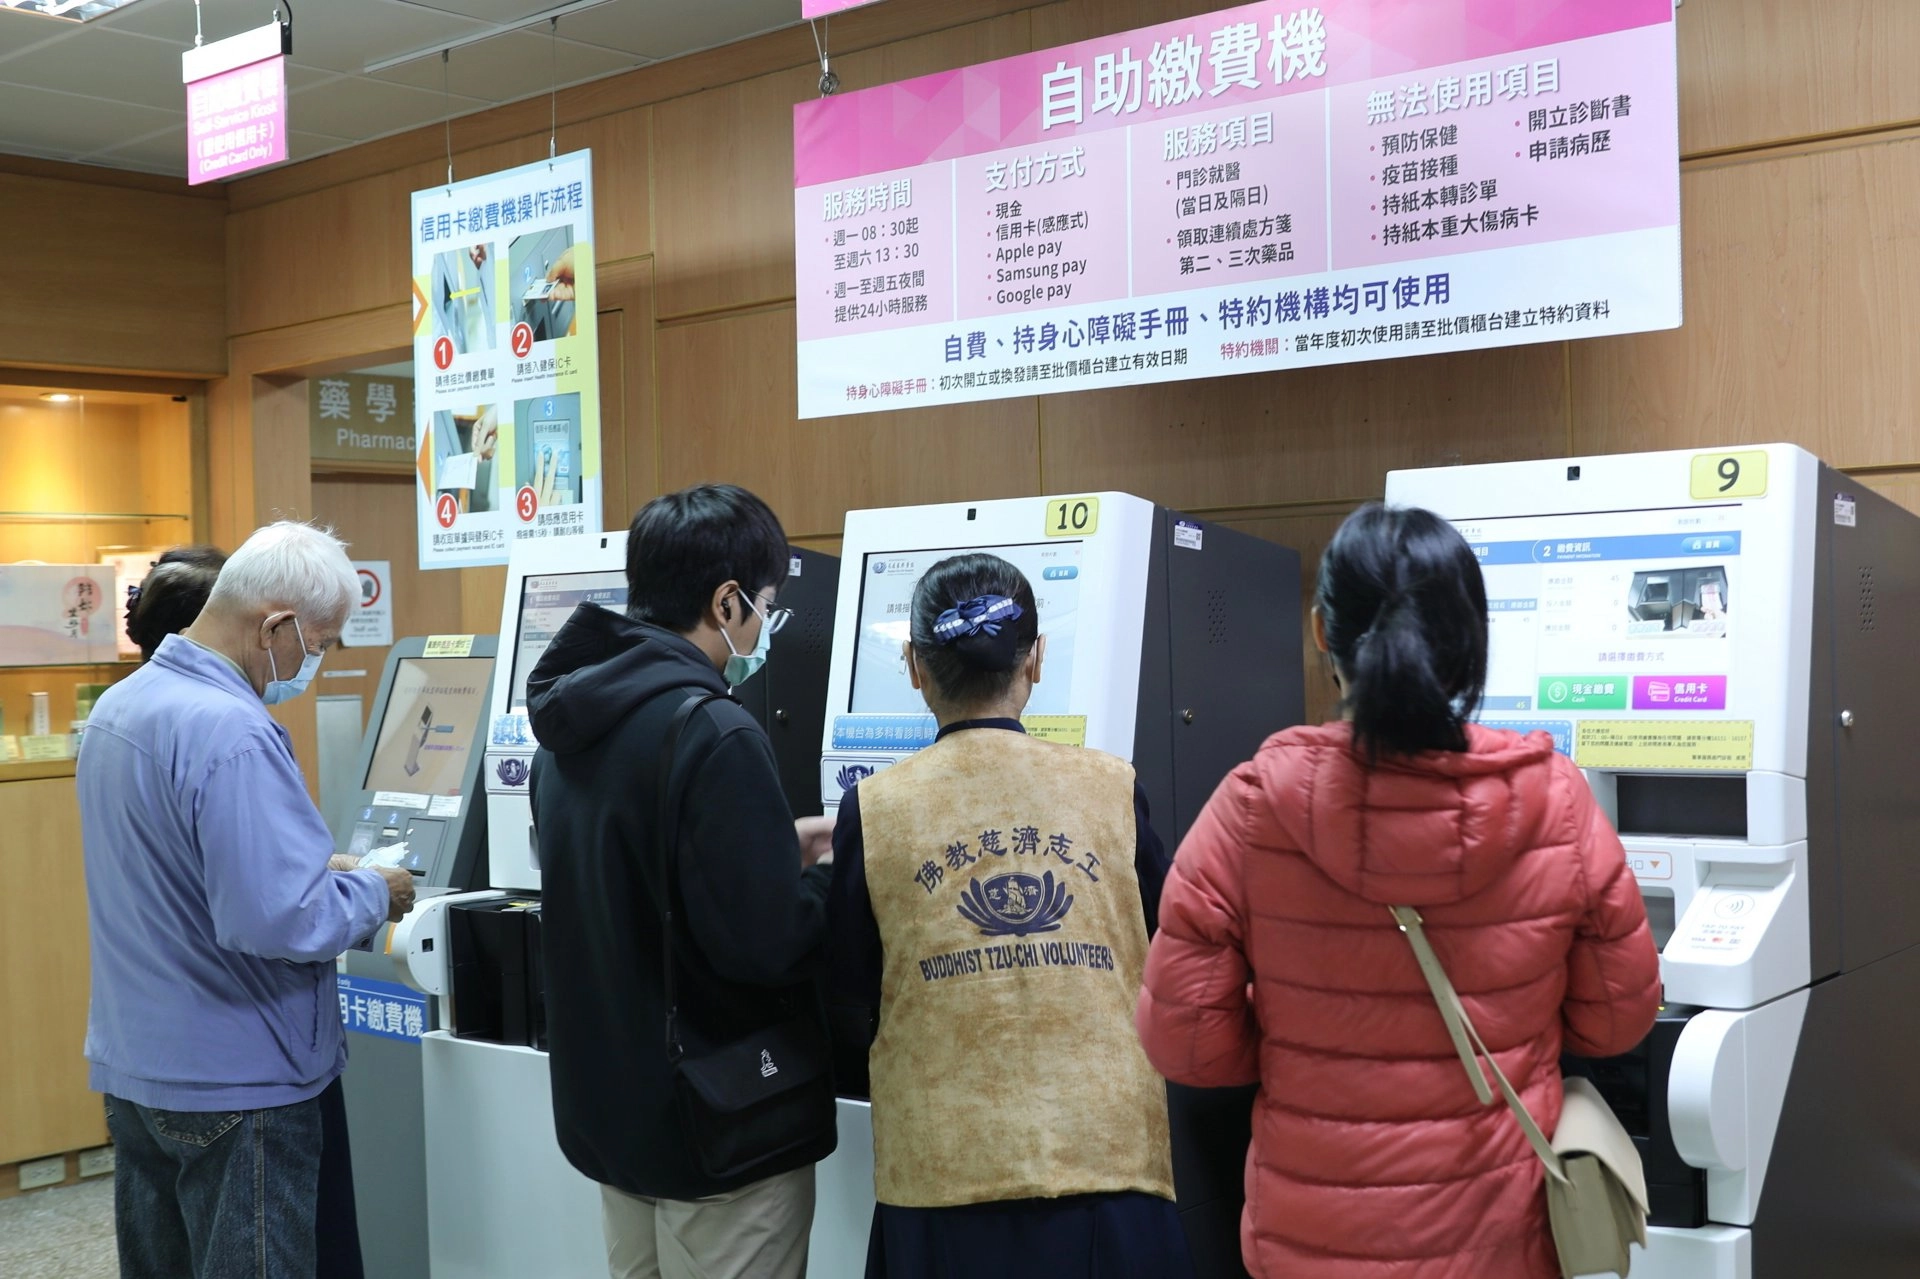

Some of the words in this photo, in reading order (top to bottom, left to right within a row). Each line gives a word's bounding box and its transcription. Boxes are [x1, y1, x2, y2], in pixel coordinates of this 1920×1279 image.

[1042, 7, 1328, 130] 自助繳費機
[1366, 58, 1560, 126] 無法使用項目
[250, 100, 278, 119] Kiosk
[1527, 94, 1632, 133] 開立診斷書
[1163, 111, 1274, 162] 服務項目
[1381, 124, 1458, 157] 預防保健
[1528, 129, 1611, 163] 申請病歷
[228, 149, 248, 166] Card
[984, 145, 1085, 193] 支付方式
[1382, 153, 1459, 187] 疫苗接種
[1176, 161, 1241, 190] 門診就醫
[420, 181, 583, 243] 信用卡繳費機操作流程
[823, 178, 912, 221] 服務時間
[995, 200, 1023, 219] 現金
[1175, 184, 1268, 219] (當日及隔日)
[1382, 178, 1498, 216] 持紙本轉診單
[996, 210, 1089, 242] 信用卡(感應式)
[1177, 213, 1293, 249] 領取連續處方箋
[1383, 203, 1540, 246] 持紙本重大傷病卡
[996, 243, 1035, 265] Apple
[1038, 239, 1063, 260] pay
[1179, 241, 1295, 276] 第二、三次藥品
[834, 269, 925, 299] 週一至週五夜間
[997, 260, 1059, 283] Samsung
[1062, 258, 1087, 277] pay
[835, 294, 928, 324] 提供24小時服務
[997, 283, 1044, 306] Google
[1047, 283, 1072, 301] pay
[438, 341, 447, 366] 1
[516, 327, 528, 355] 2
[319, 379, 415, 423] 藥學
[1717, 458, 1740, 492] 9
[440, 498, 453, 525] 4
[521, 492, 533, 517] 3
[1056, 501, 1089, 530] 10
[1543, 545, 1552, 557] 2
[1674, 682, 1708, 695] 信用卡
[836, 726, 939, 740] 本機台為多科看診同時
[914, 825, 1100, 894] 佛教慈濟志工
[919, 949, 982, 982] BUDDHIST
[1040, 942, 1114, 971] VOLUNTEERS
